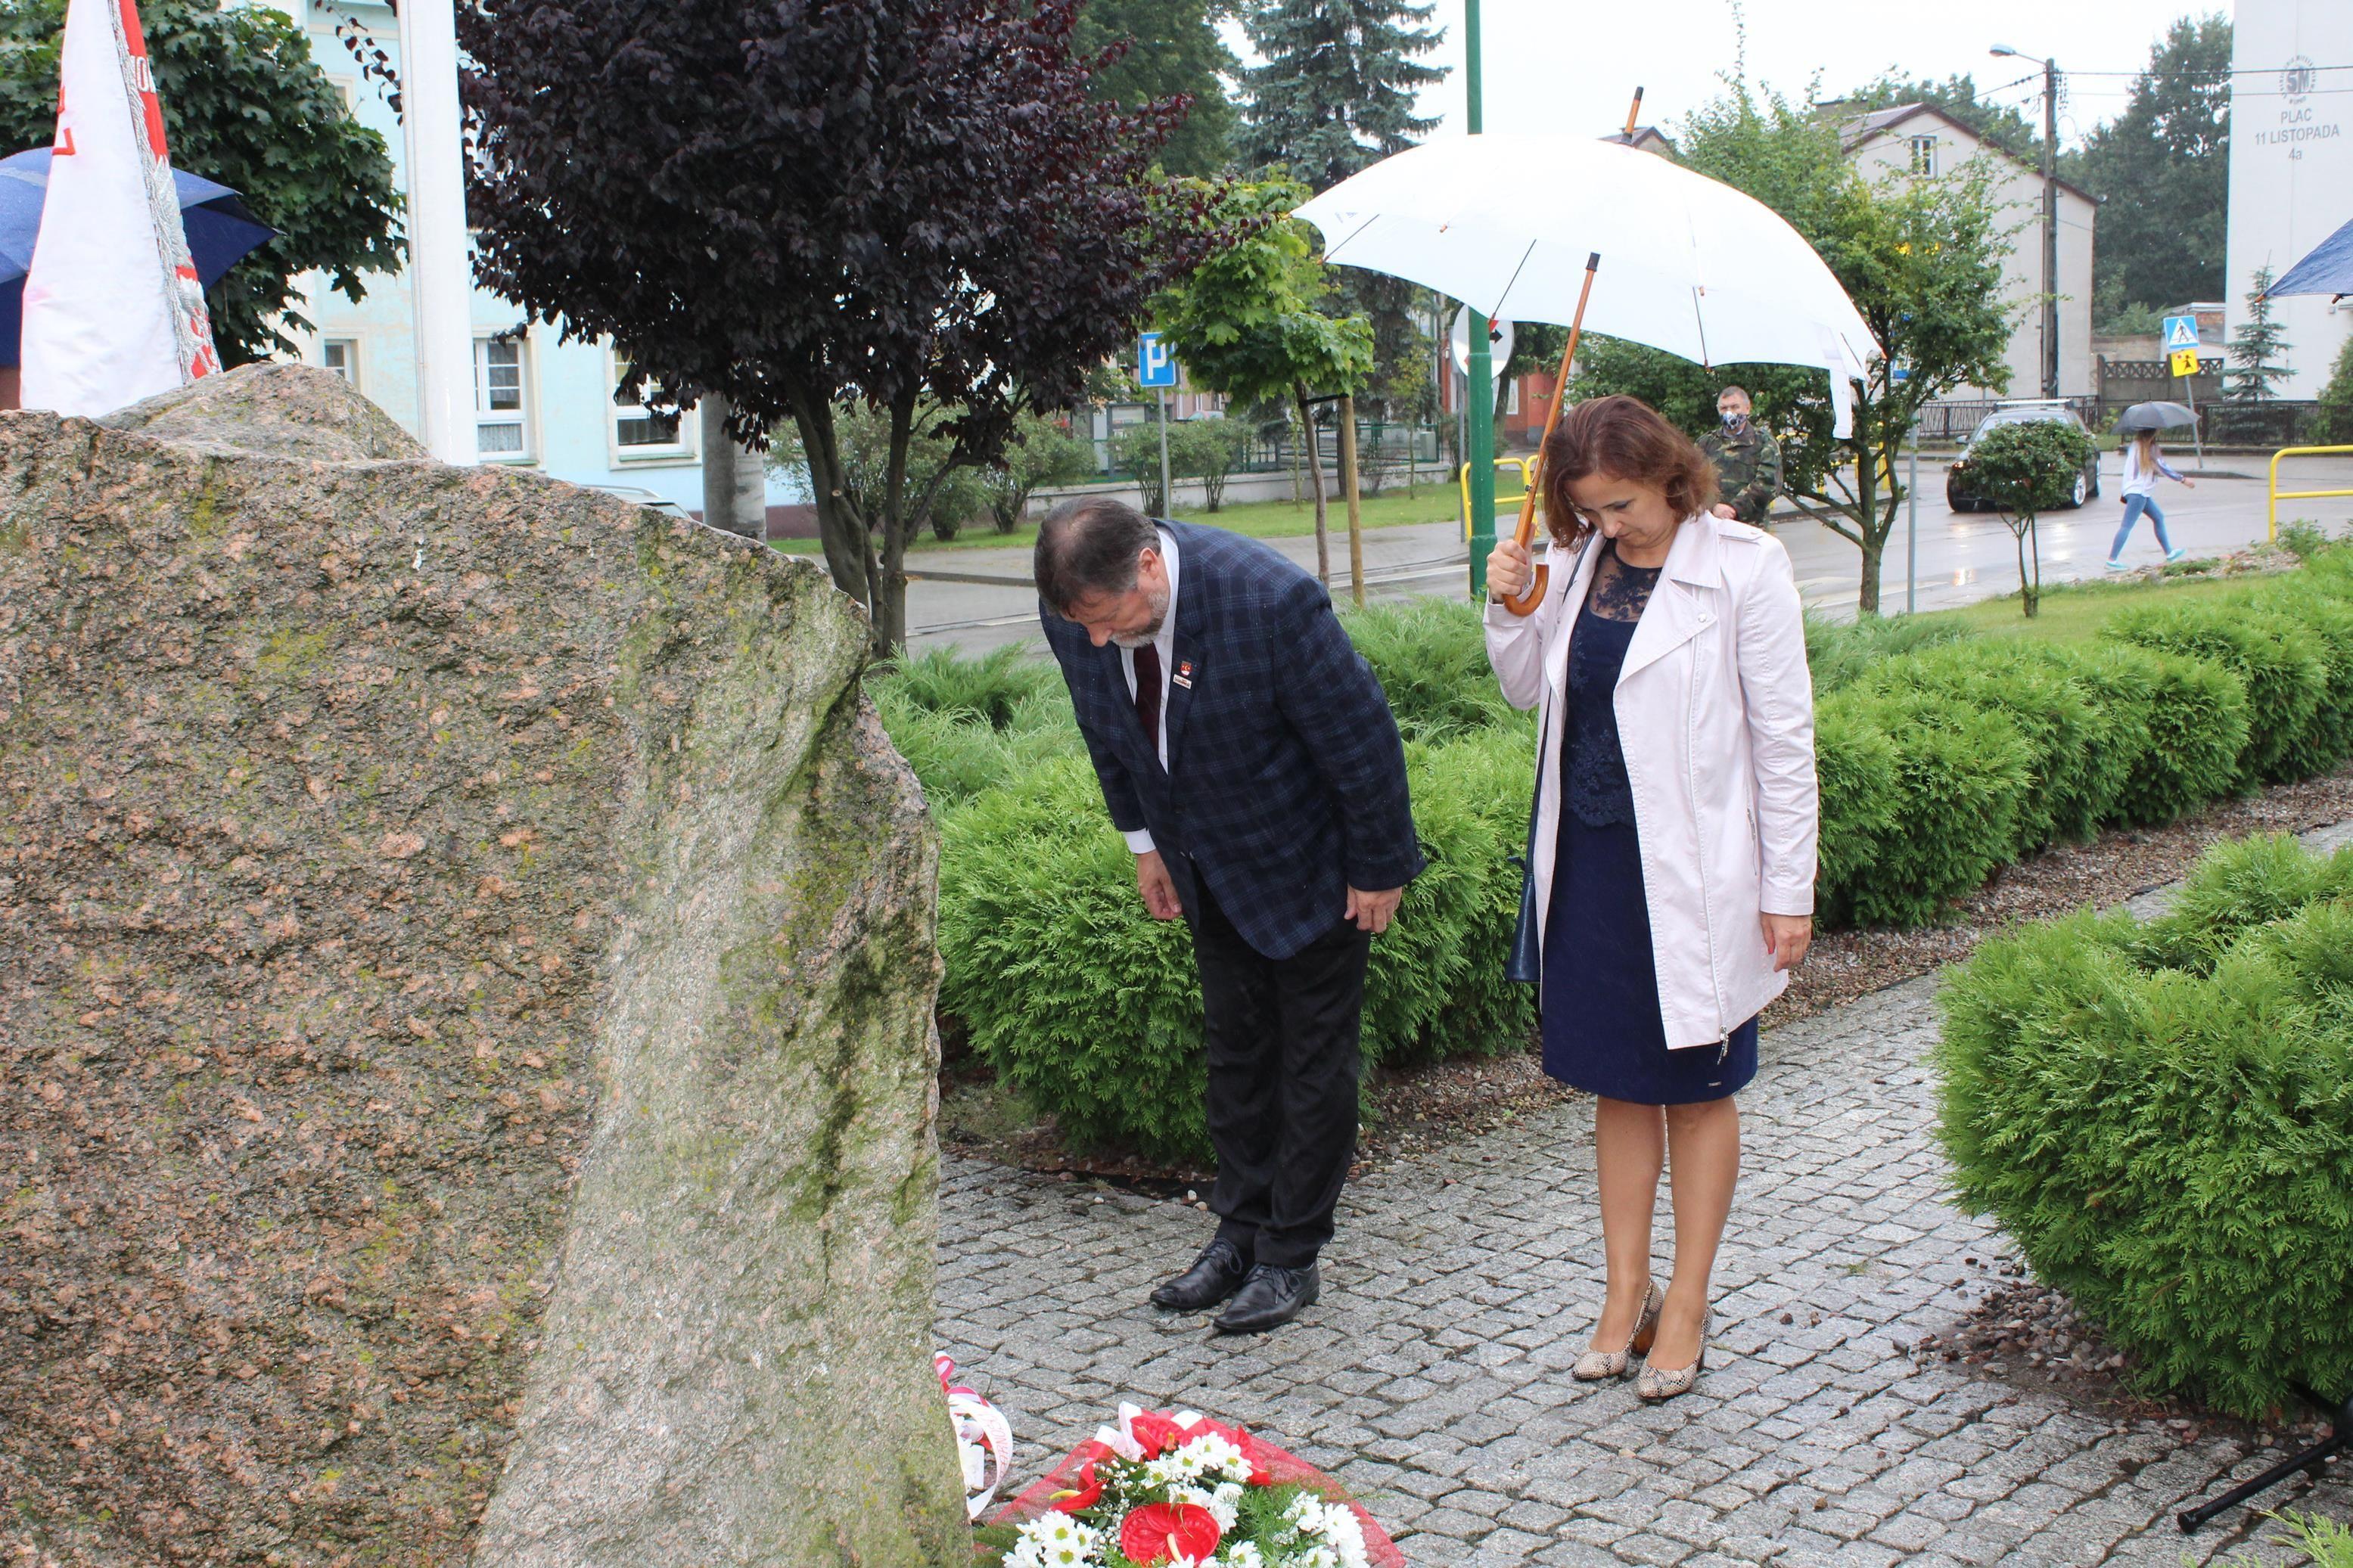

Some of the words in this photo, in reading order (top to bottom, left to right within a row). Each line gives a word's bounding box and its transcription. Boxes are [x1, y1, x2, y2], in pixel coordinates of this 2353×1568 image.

[2287, 66, 2310, 94] SM
[2280, 107, 2312, 123] PLAC
[2255, 132, 2266, 145] 11
[2270, 123, 2340, 144] LISTOPADA
[2289, 147, 2302, 161] 4a
[1146, 340, 1167, 380] P
